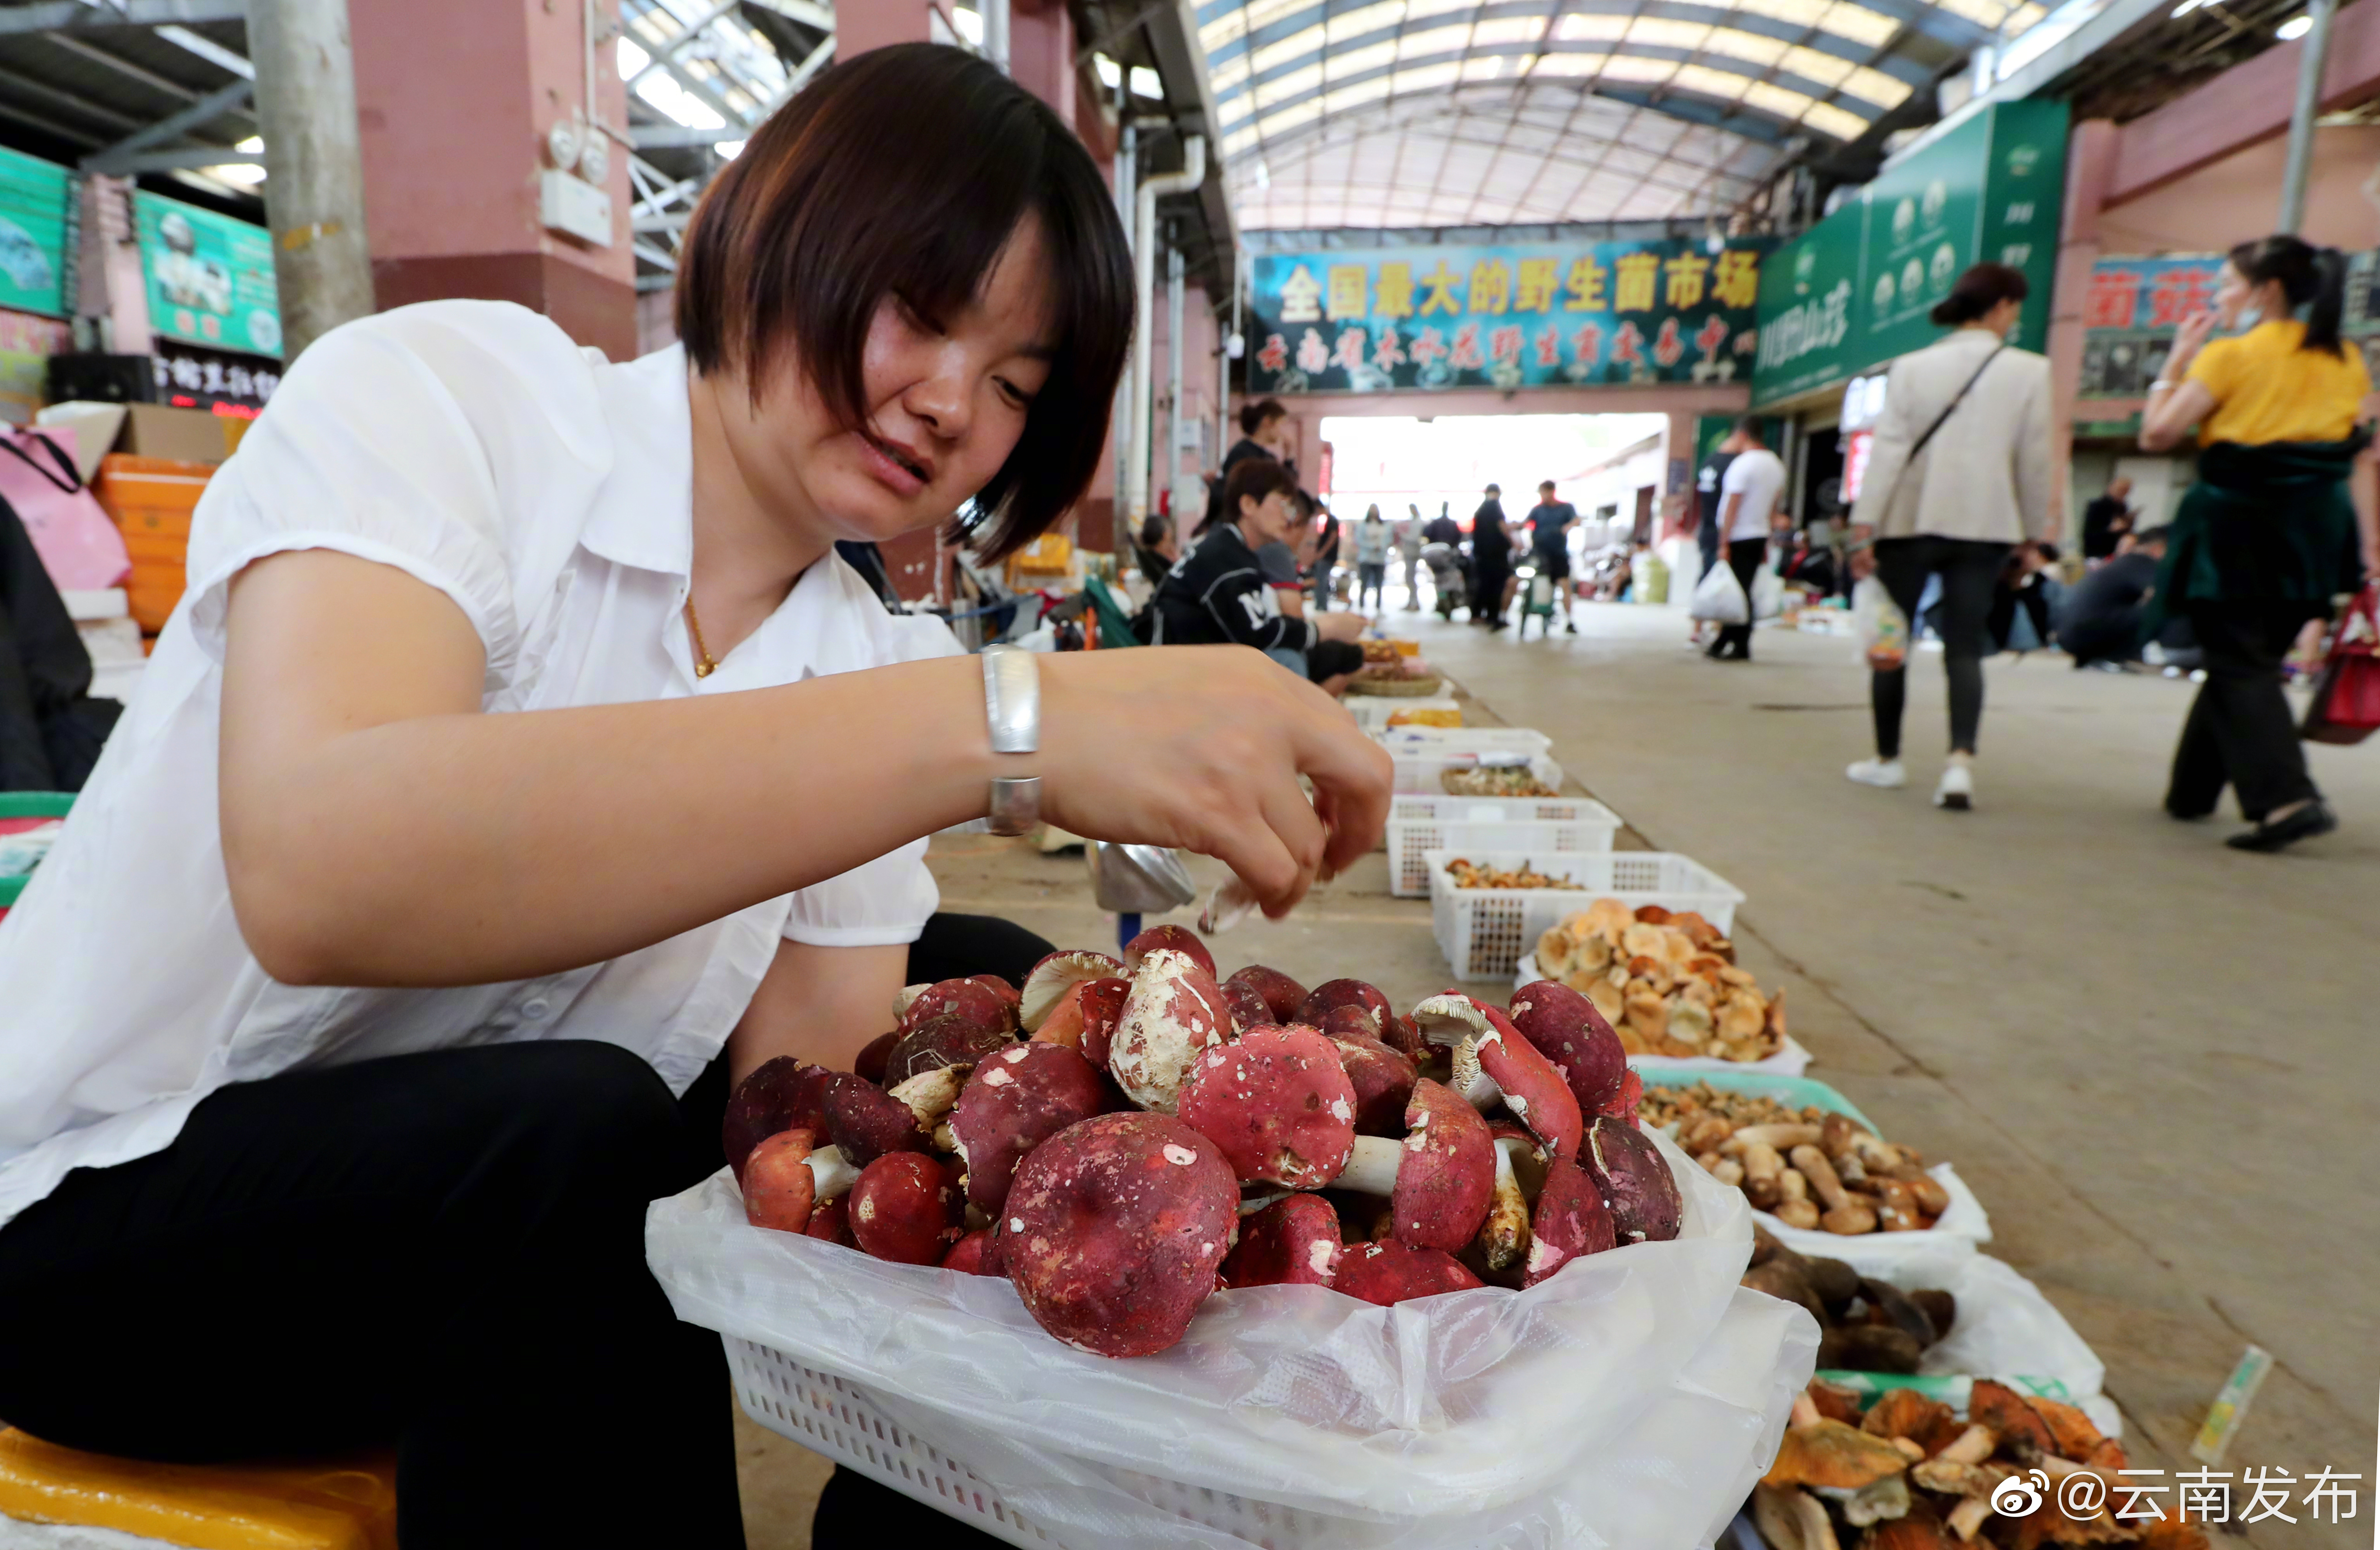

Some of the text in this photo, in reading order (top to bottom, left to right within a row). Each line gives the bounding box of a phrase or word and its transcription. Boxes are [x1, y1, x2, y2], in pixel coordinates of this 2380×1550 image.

[1280, 249, 1760, 323] 全国最大的野生菌市场
